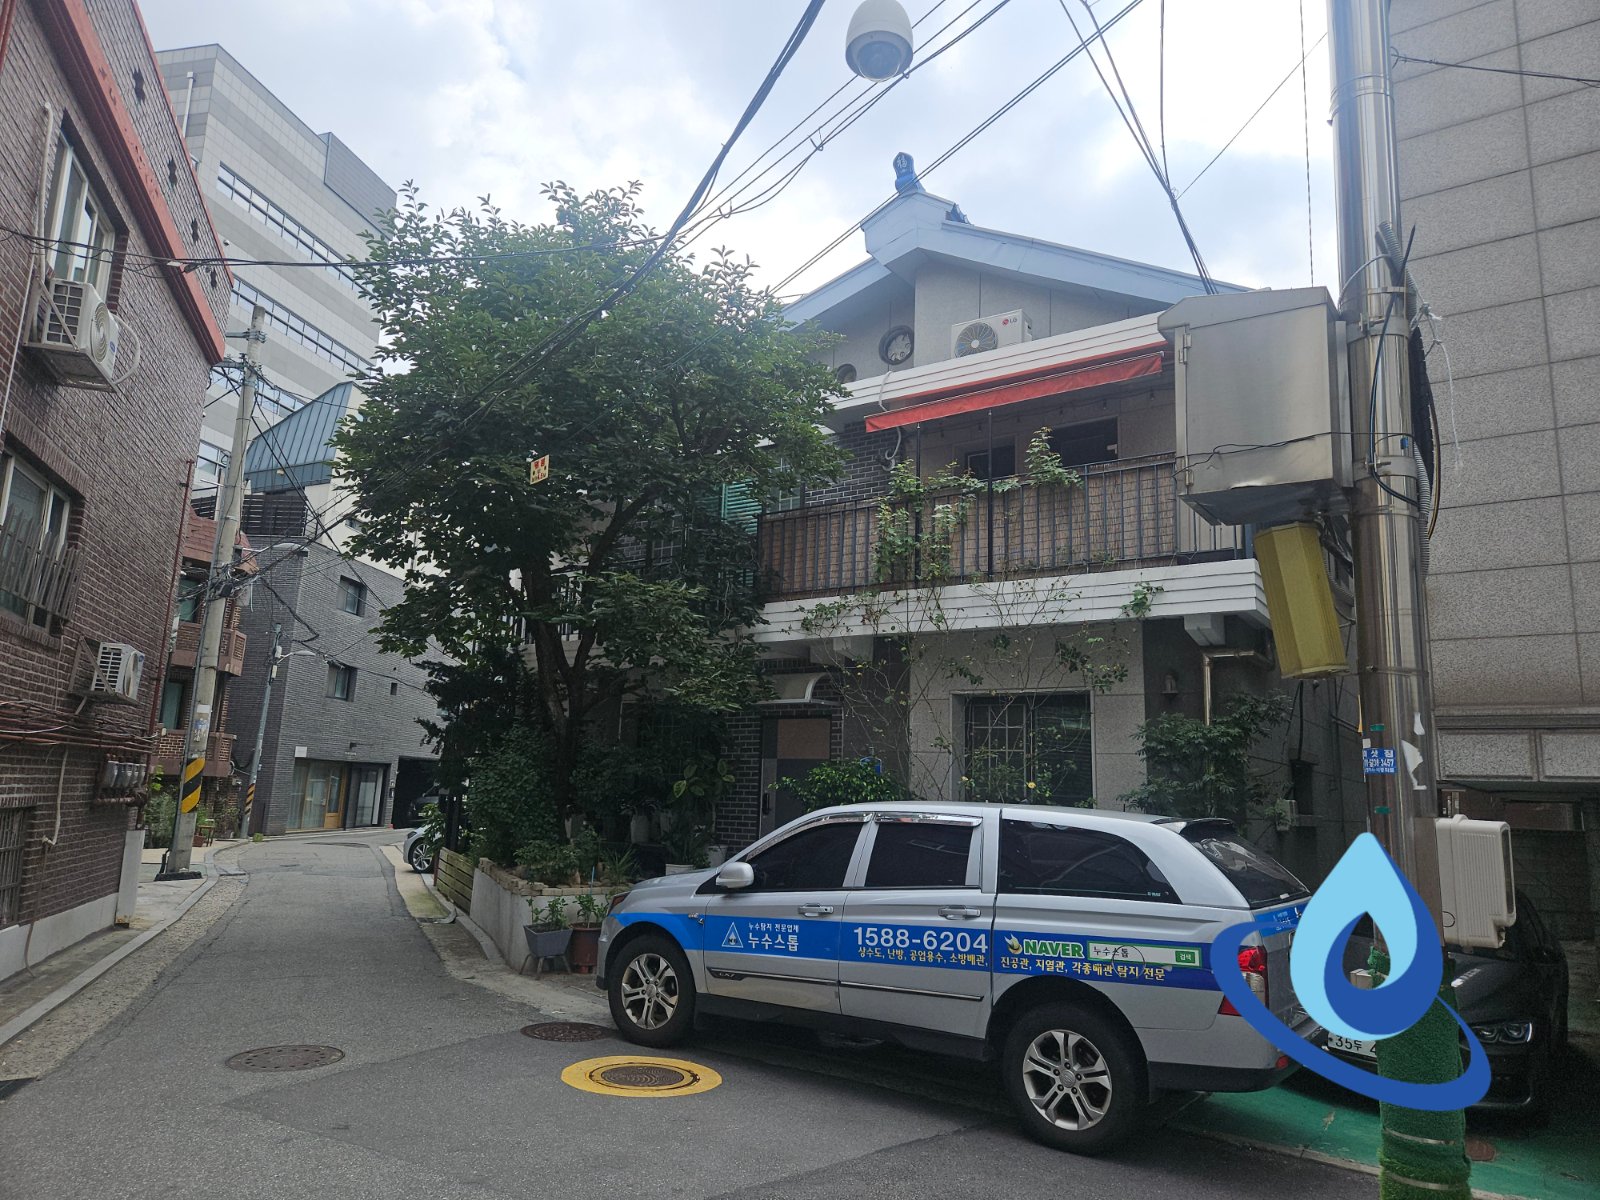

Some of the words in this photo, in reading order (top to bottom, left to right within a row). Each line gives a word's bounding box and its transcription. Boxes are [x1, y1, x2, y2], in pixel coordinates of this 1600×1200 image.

[748, 932, 799, 952] 누수스톱
[853, 926, 988, 953] 1588-6204
[1023, 939, 1085, 958] NAVER
[858, 946, 885, 959] 상수도,
[887, 948, 907, 961] 난방,
[910, 950, 947, 965] 공업용수,
[949, 952, 988, 968] 소방배관,
[1093, 945, 1129, 958] 누수스톱
[1179, 953, 1192, 961] 검색
[1000, 956, 1032, 971] 진공관,
[1035, 959, 1068, 973] 지열관,
[1072, 961, 1113, 977] 각종배관
[1117, 965, 1139, 978] 탐지
[1143, 967, 1166, 981] 전문
